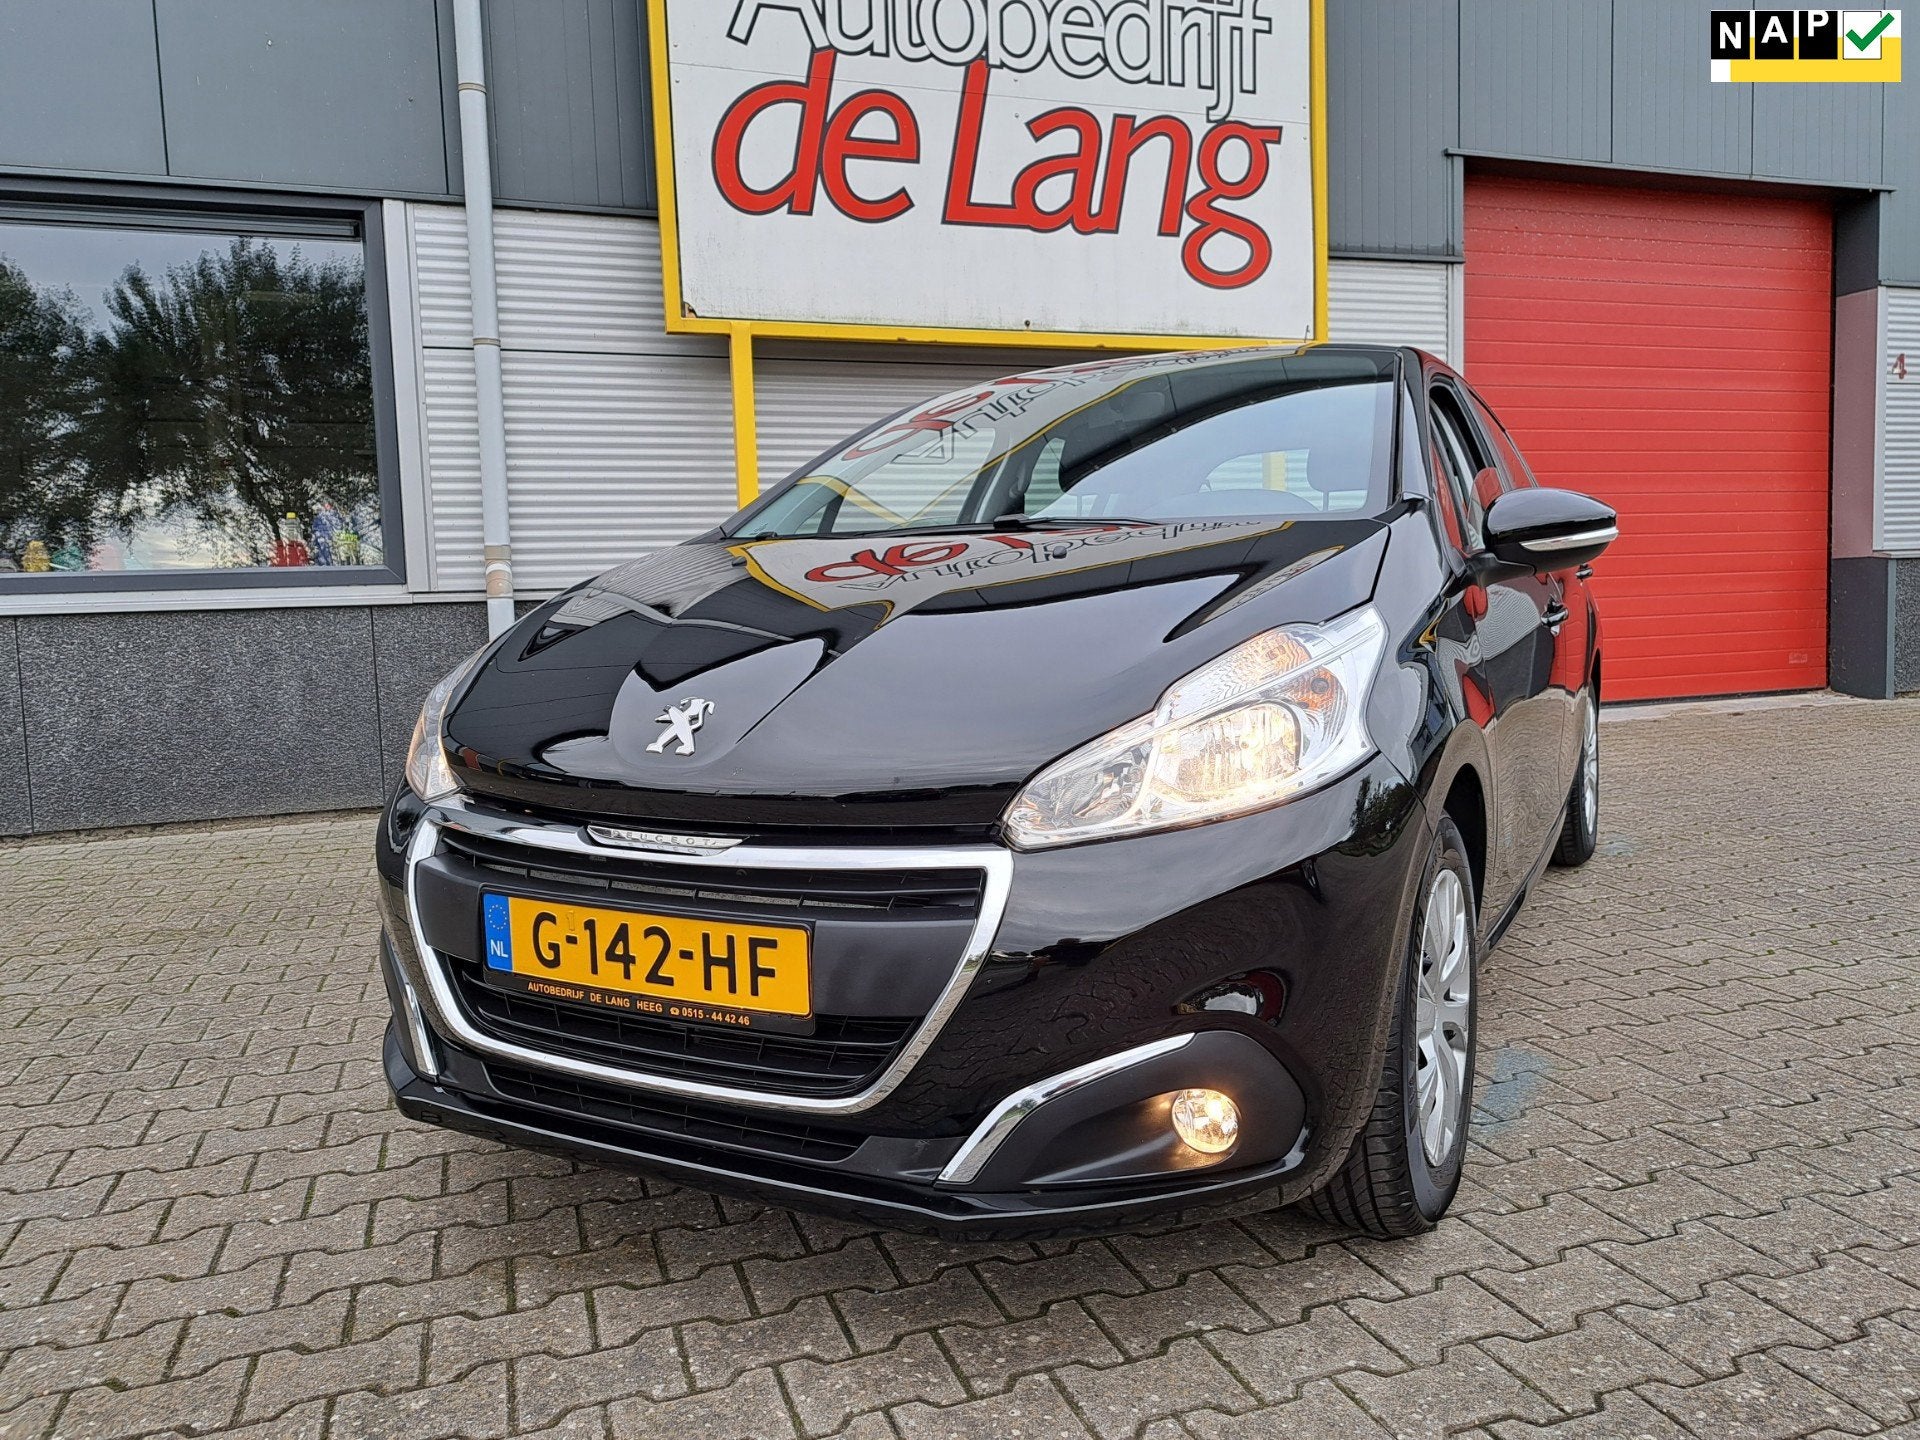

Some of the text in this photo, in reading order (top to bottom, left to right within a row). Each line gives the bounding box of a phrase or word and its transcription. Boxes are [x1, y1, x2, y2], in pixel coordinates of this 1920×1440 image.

[711, 49, 1283, 290] de Lang
[1892, 353, 1908, 380] 4
[611, 829, 713, 846] PEUGEOT
[490, 939, 509, 958] NL
[532, 911, 778, 997] G-142-HF
[527, 981, 585, 1000] AUTOBEDRIJF
[590, 992, 602, 1003] DE
[605, 995, 630, 1008] LANG
[636, 1000, 663, 1013] HEEG
[682, 1006, 704, 1019] 0515
[711, 1011, 723, 1022] 44
[725, 1013, 736, 1024] 42
[738, 1015, 750, 1026] 46
